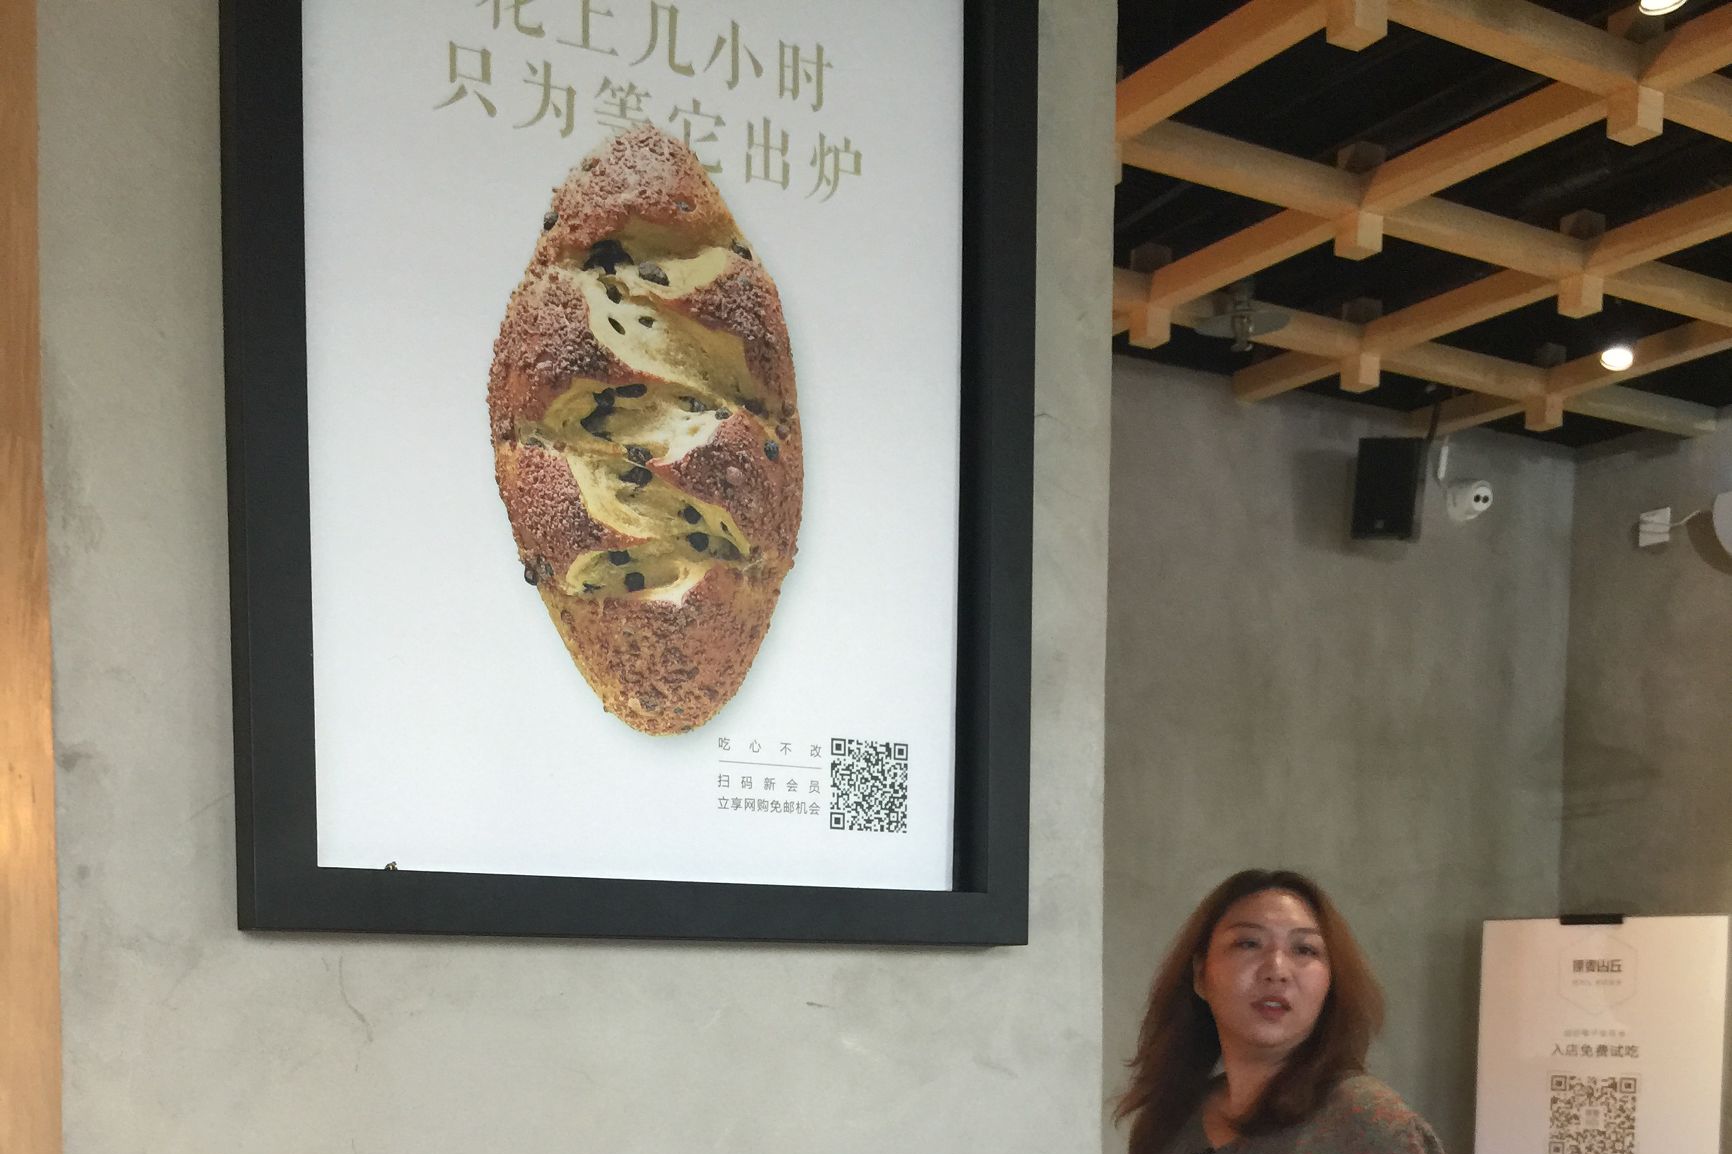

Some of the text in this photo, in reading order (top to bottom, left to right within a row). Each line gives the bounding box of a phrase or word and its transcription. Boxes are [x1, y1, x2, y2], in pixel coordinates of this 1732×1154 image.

[718, 736, 823, 758] 吃心不改
[717, 773, 821, 794] 扫码新会员
[717, 797, 821, 815] 立享网购免邮机会
